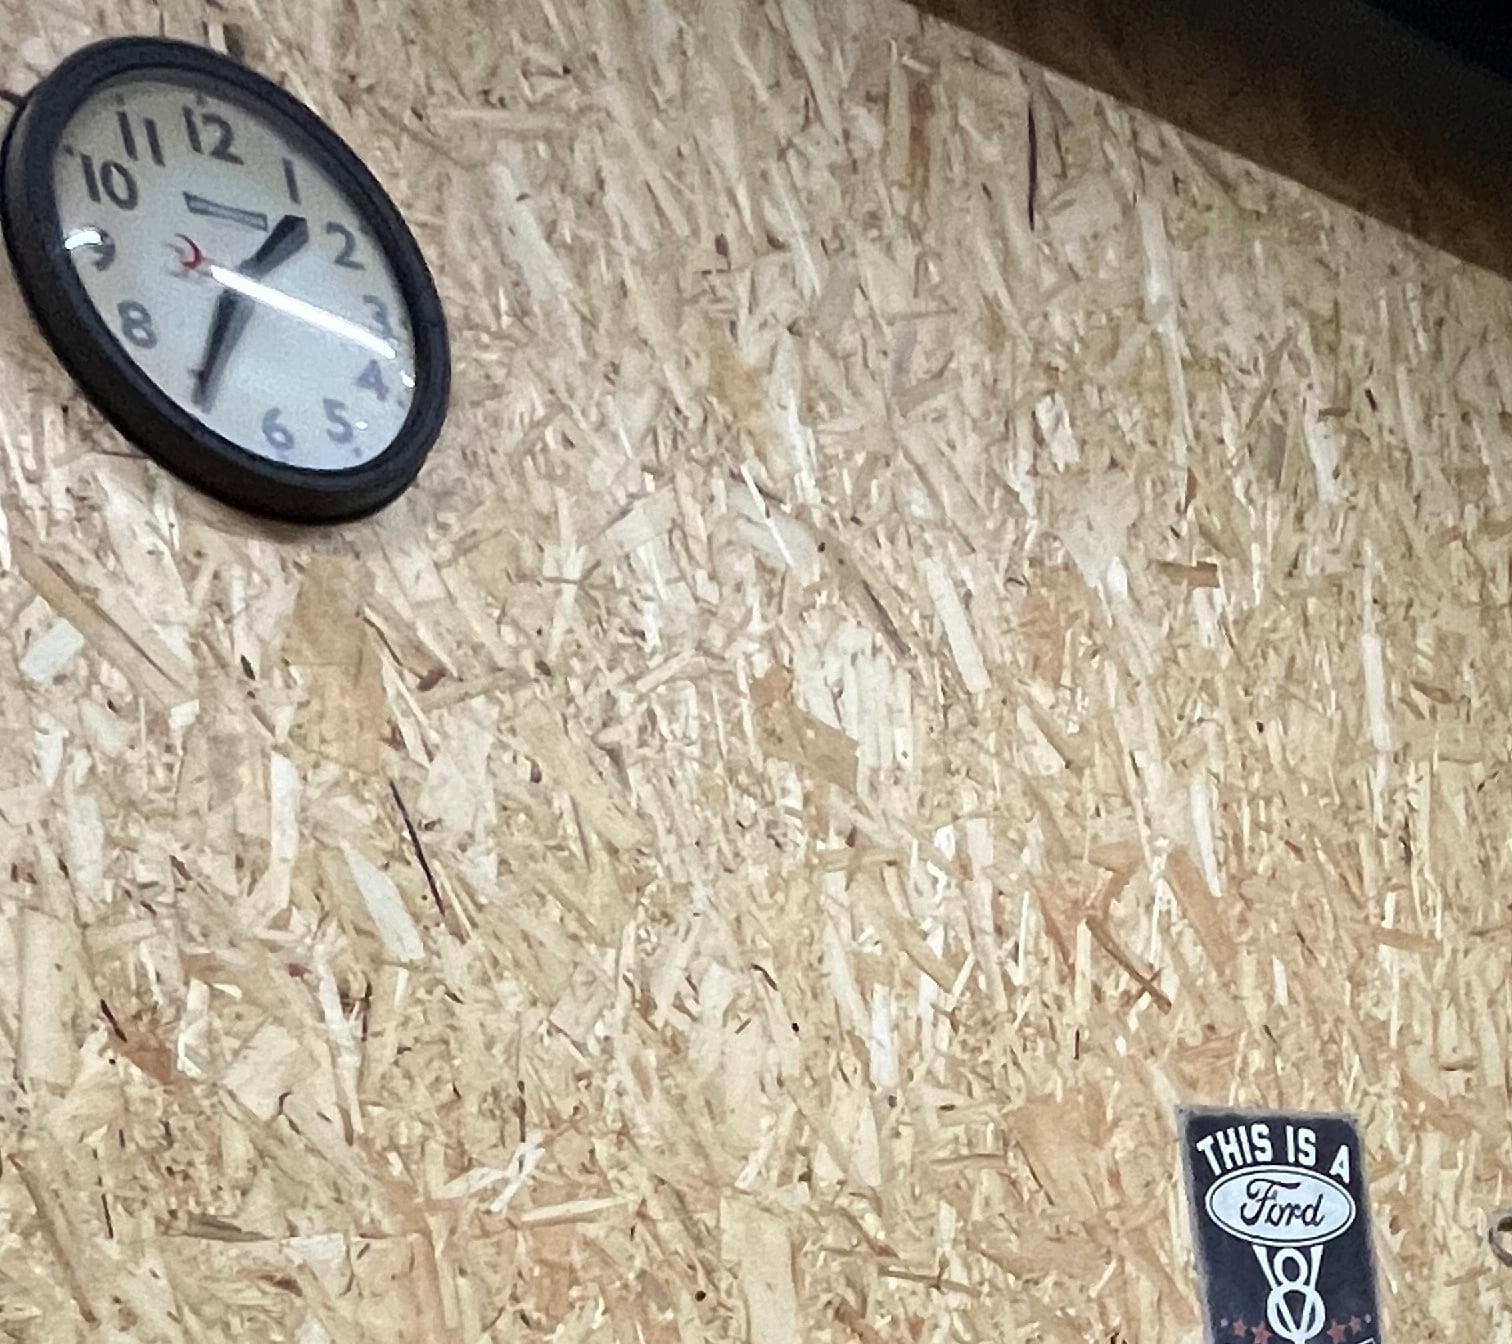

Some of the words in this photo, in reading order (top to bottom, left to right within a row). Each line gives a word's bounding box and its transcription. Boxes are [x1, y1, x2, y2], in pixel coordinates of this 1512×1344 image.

[117, 110, 166, 168] 11
[183, 105, 244, 165] 12
[80, 152, 139, 211] 10
[282, 158, 300, 204] 1
[326, 221, 365, 271] 2
[117, 301, 157, 349] 8
[354, 359, 390, 400] 4
[261, 407, 295, 450] 6
[322, 398, 354, 444] 5
[1196, 1122, 1274, 1176] THIS
[1286, 1125, 1317, 1168] IS
[1329, 1144, 1350, 1185] A
[1240, 1178, 1326, 1227] Ford
